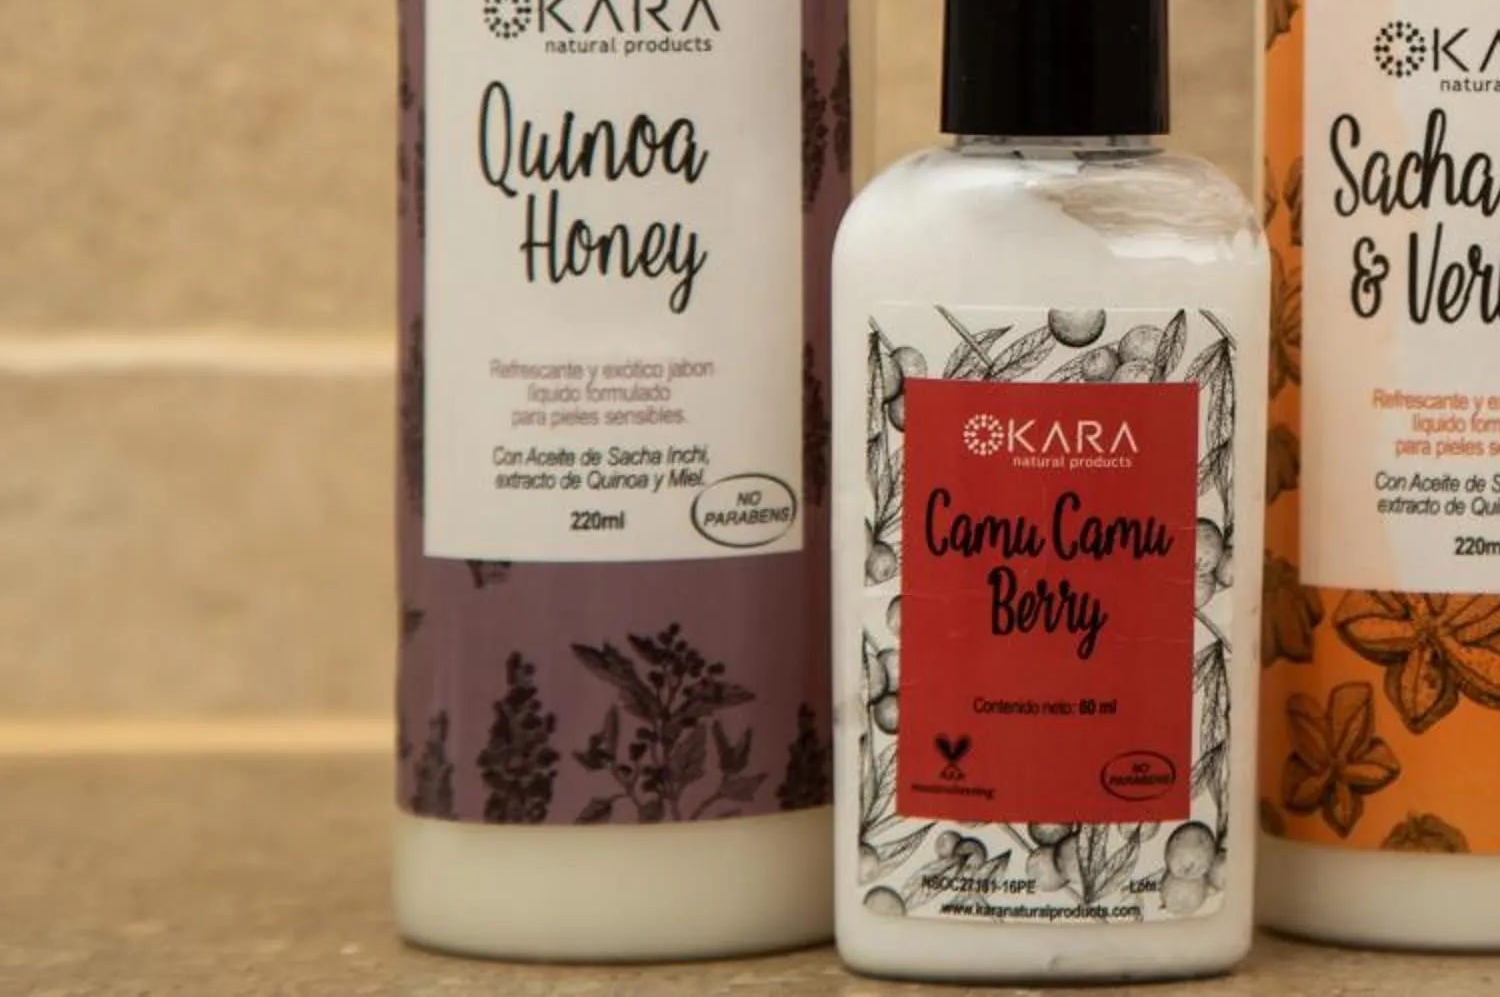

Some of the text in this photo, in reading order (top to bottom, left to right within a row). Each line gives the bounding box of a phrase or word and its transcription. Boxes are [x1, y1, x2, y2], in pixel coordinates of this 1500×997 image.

[544, 36, 714, 57] natural products
[479, 80, 708, 198] Quinoa
[520, 189, 708, 314] Honey
[1350, 235, 1391, 320] &
[489, 359, 584, 380] Refrescante
[586, 363, 599, 385] y
[586, 383, 671, 403] formulado
[1372, 389, 1469, 409] Refrescante
[1473, 395, 1485, 412] y
[511, 409, 546, 429] para
[550, 407, 599, 430] pieles
[492, 445, 523, 466] Con
[526, 446, 576, 466] Aceite
[579, 448, 603, 467] de
[607, 446, 662, 466] Sacha
[1395, 439, 1431, 458] para
[1435, 438, 1485, 458] pieles
[1013, 456, 1133, 471] natural products
[494, 471, 557, 490] extracto
[559, 470, 582, 490] de
[586, 470, 649, 491] Quinoa
[651, 474, 665, 493] y
[1375, 471, 1407, 492] Con
[1409, 473, 1461, 493] Aceite
[1464, 475, 1486, 493] de
[735, 491, 763, 507] NO
[1377, 498, 1441, 516] extracto
[1444, 498, 1467, 515] de
[569, 510, 625, 532] 220ml
[703, 507, 791, 527] PARABENS
[925, 488, 1174, 561] Camu Camu
[987, 565, 1109, 660] Berry
[973, 697, 1040, 716] Contenido
[1099, 699, 1118, 715] ml
